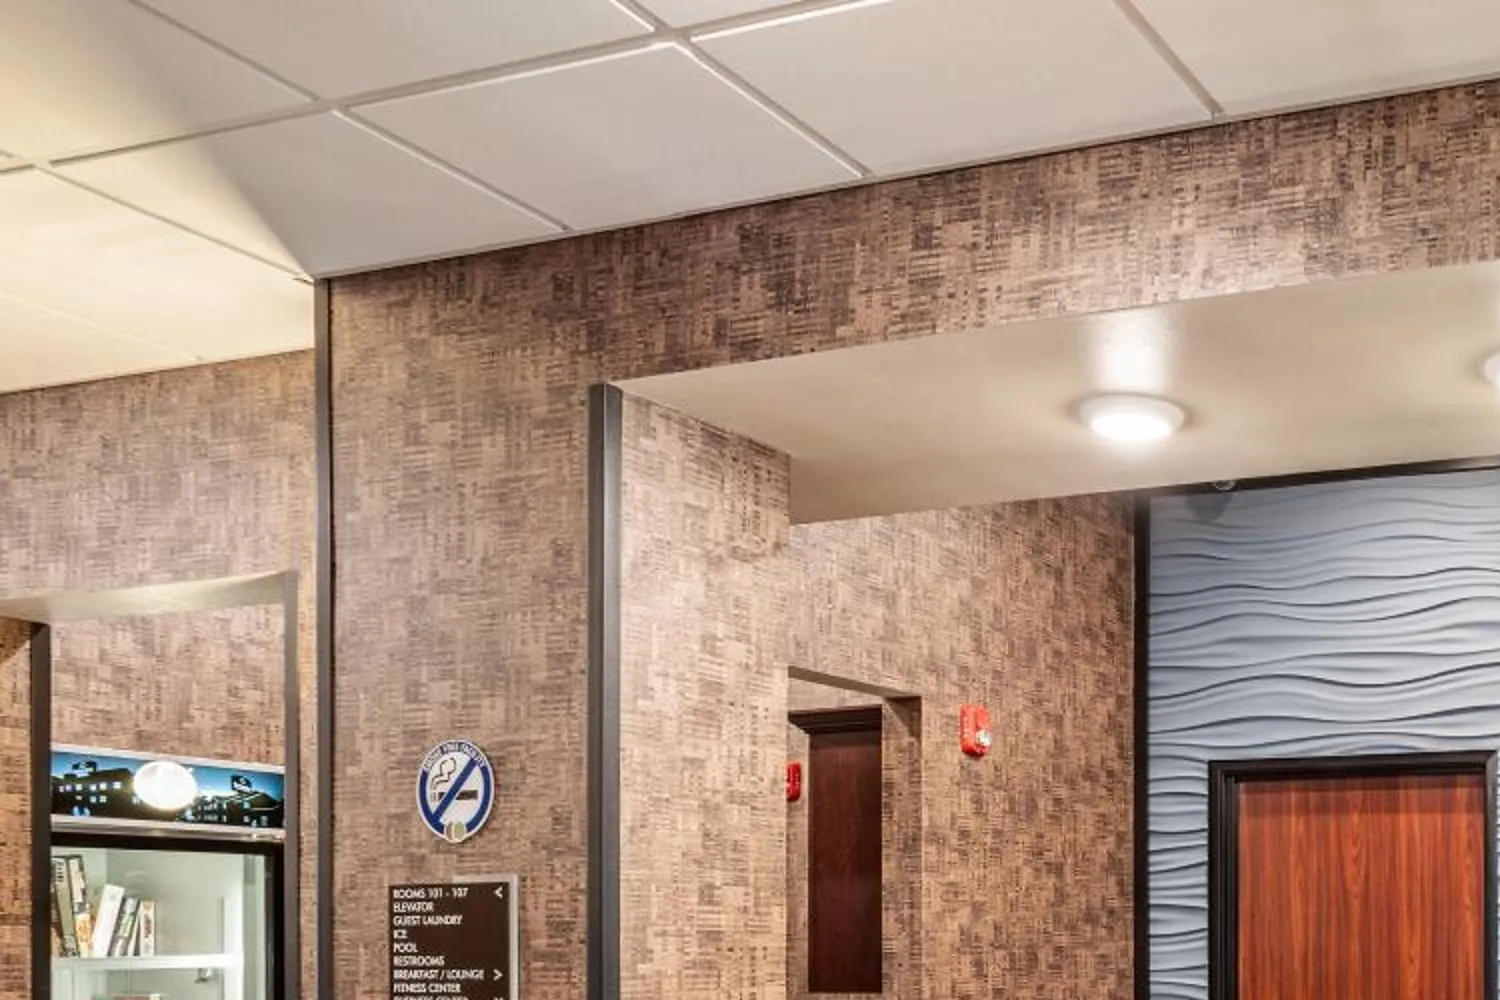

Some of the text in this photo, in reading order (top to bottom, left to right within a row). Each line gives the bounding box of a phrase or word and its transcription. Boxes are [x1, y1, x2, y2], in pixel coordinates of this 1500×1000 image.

[393, 887, 426, 899] ROOMS
[428, 888, 443, 899] 101
[452, 887, 469, 898] 107
[393, 902, 434, 913] ELEVATOR
[393, 914, 463, 926] GUEST LAUNDRY
[393, 929, 408, 939] ICE
[393, 943, 418, 953] POOL
[393, 955, 445, 966] RESTROOMS
[393, 969, 438, 980] BREAKFAST
[446, 969, 485, 980] LOUNGE
[393, 983, 461, 993] FITNESS CENTER
